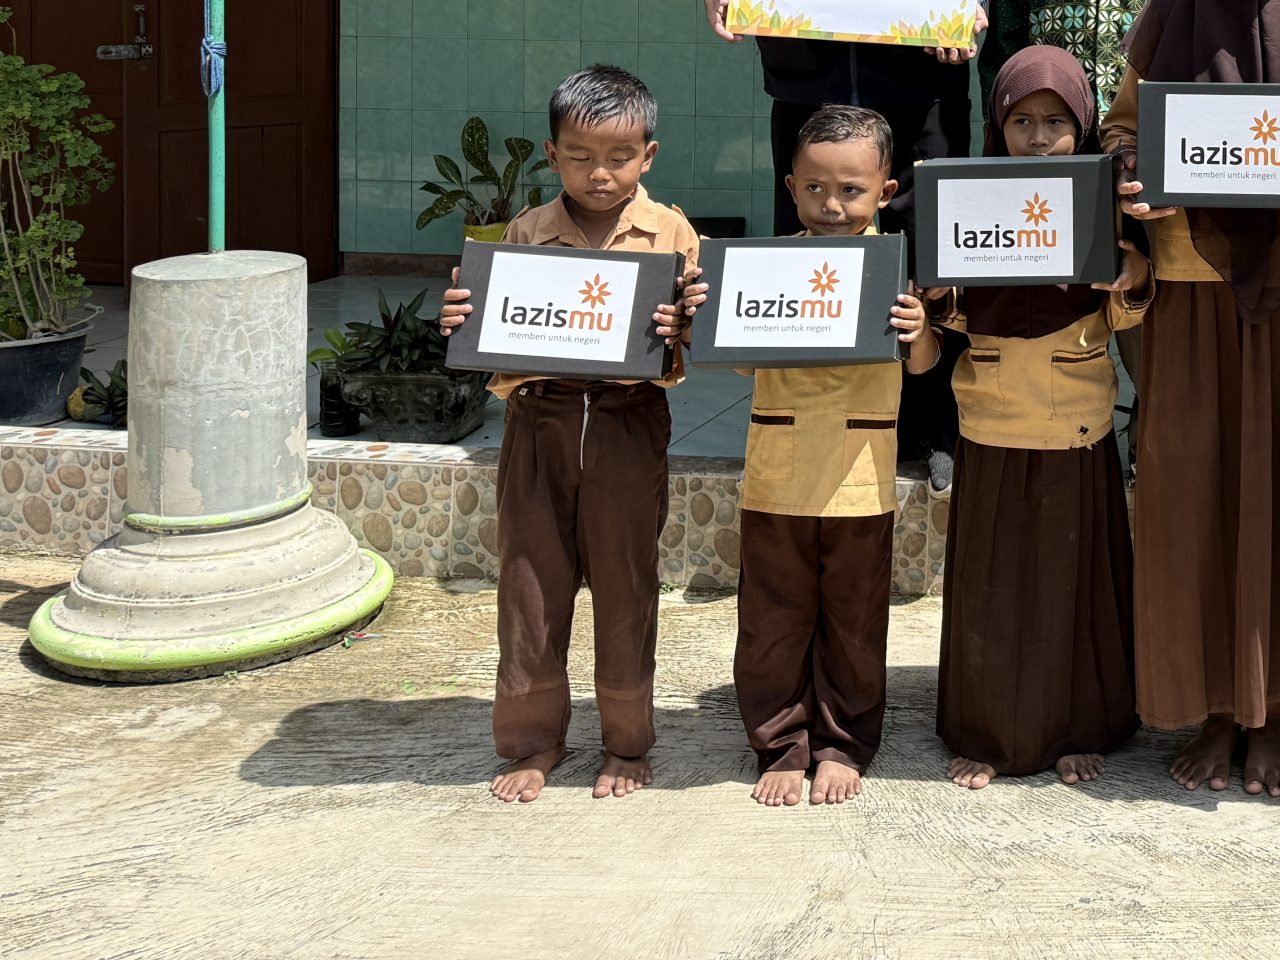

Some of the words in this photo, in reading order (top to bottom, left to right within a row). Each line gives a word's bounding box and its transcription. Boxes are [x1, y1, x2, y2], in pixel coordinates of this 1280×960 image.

[1190, 170, 1226, 179] memberi
[1227, 171, 1250, 179] untuk
[1251, 173, 1277, 181] negeri
[953, 222, 1056, 248] lazismu
[963, 254, 999, 262] memberi
[1000, 254, 1023, 262] untuk
[1024, 254, 1049, 263] negeri
[735, 290, 842, 318] lazismu
[500, 296, 612, 331] lazismu
[743, 324, 780, 332] memberi
[781, 324, 804, 332] untuk
[806, 326, 831, 334] negeri
[508, 332, 546, 341] memberi
[548, 335, 572, 343] untuk
[574, 337, 600, 346] negeri
